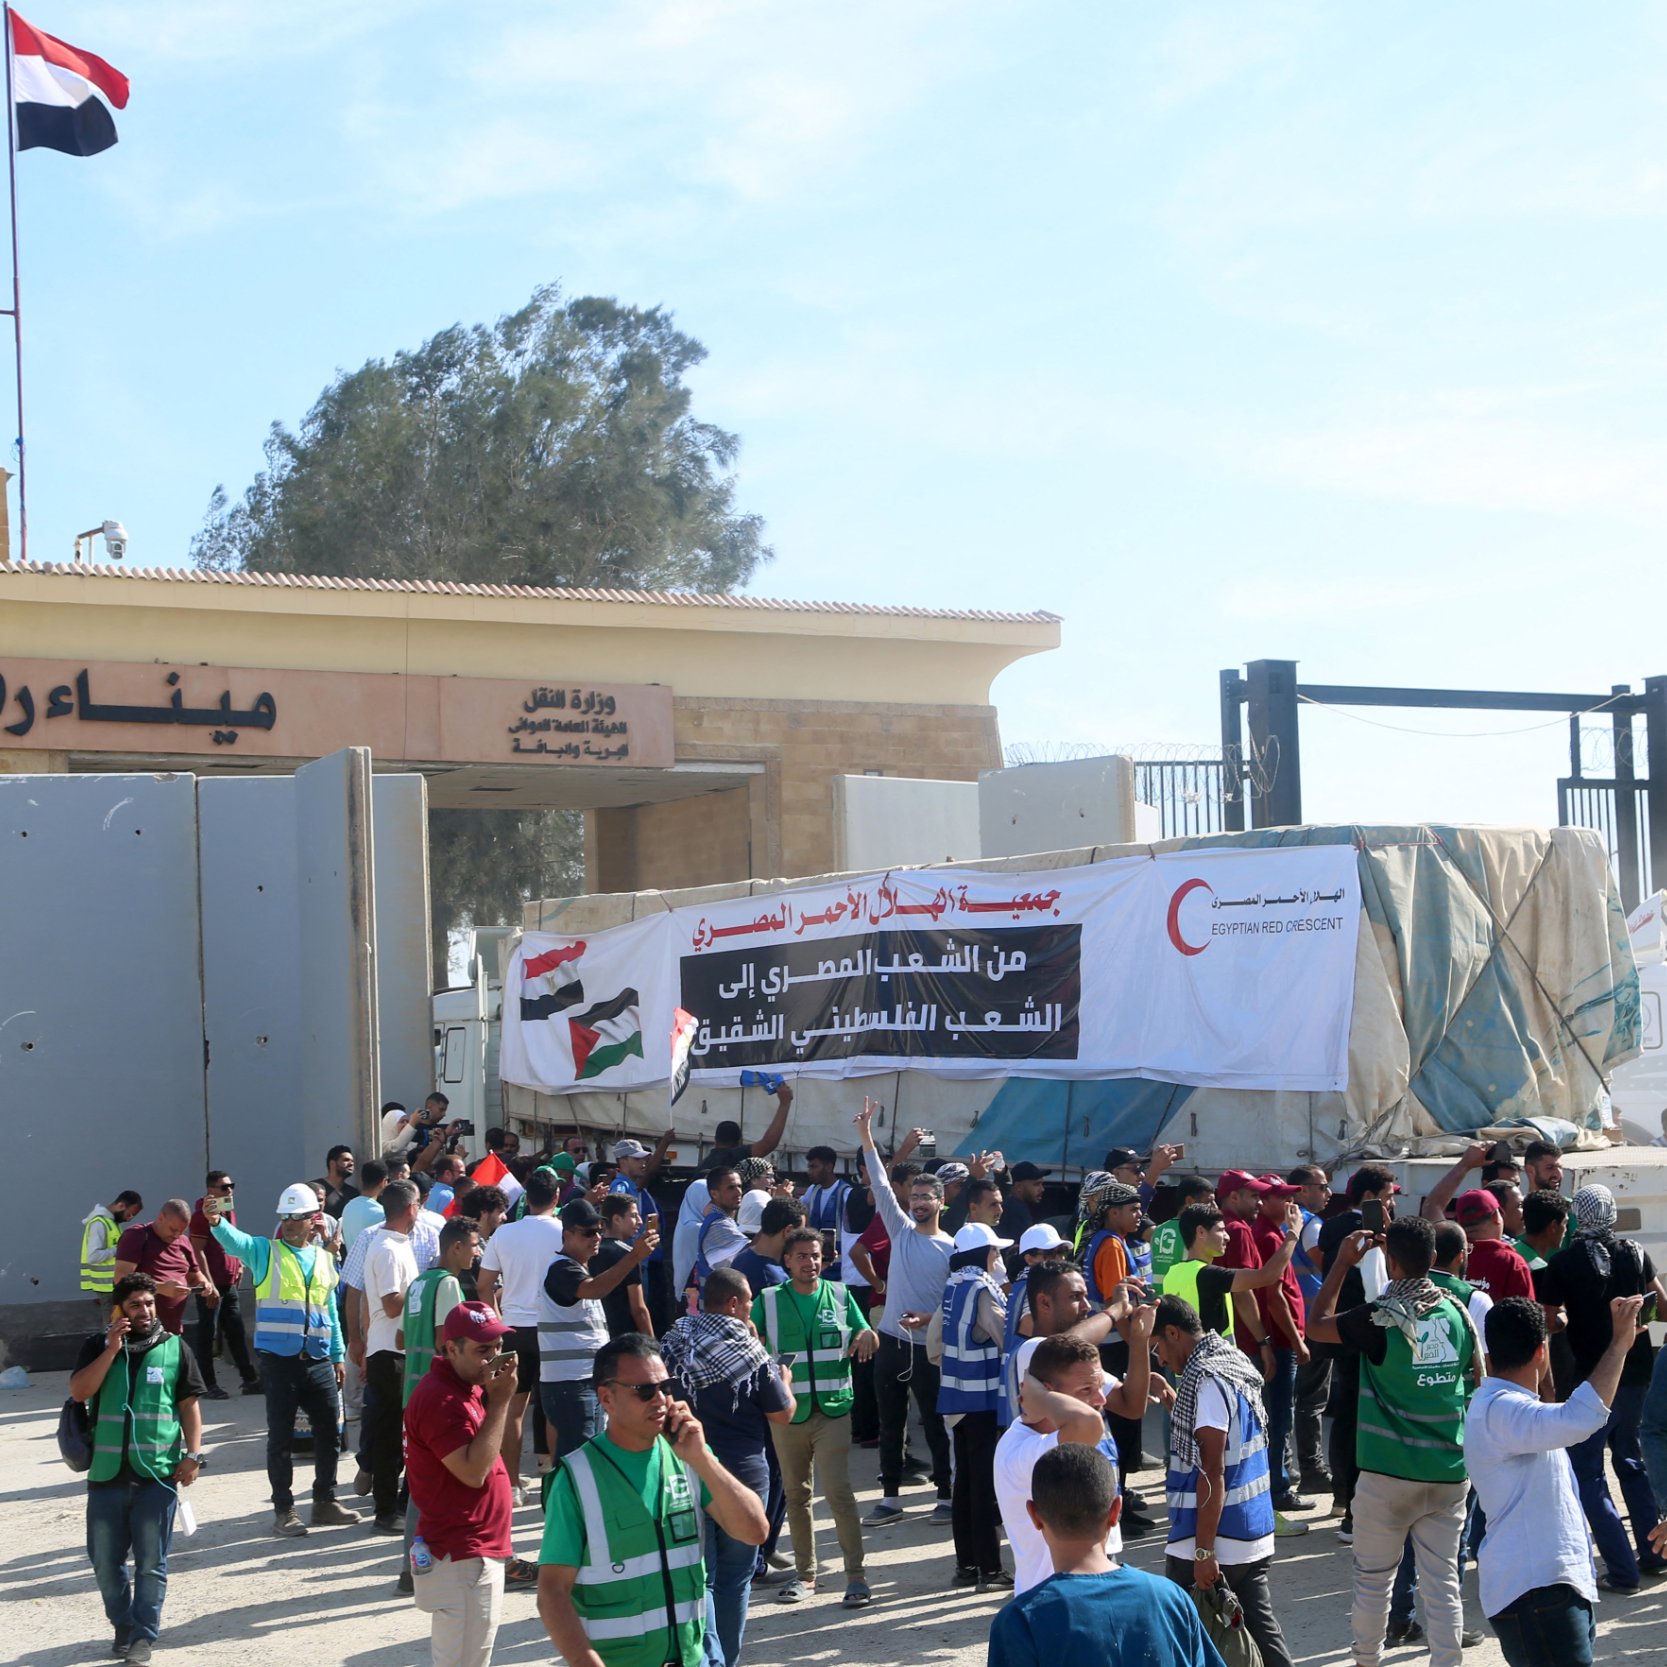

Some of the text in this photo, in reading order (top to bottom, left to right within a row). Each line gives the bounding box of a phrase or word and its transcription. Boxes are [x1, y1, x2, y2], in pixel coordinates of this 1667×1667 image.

[46, 661, 277, 746] ميناء
[523, 686, 616, 716] وزارة النقل
[692, 884, 1062, 952] جمعية الهلال الأحمر المصري
[1211, 916, 1344, 936] EGYPTIAN RED CRESCENT
[718, 937, 1027, 1003] من الشعب المصري إلى
[690, 995, 1062, 1056] الشعب الفلسطيني الشقيق
[1416, 1371, 1456, 1387] متطوع
